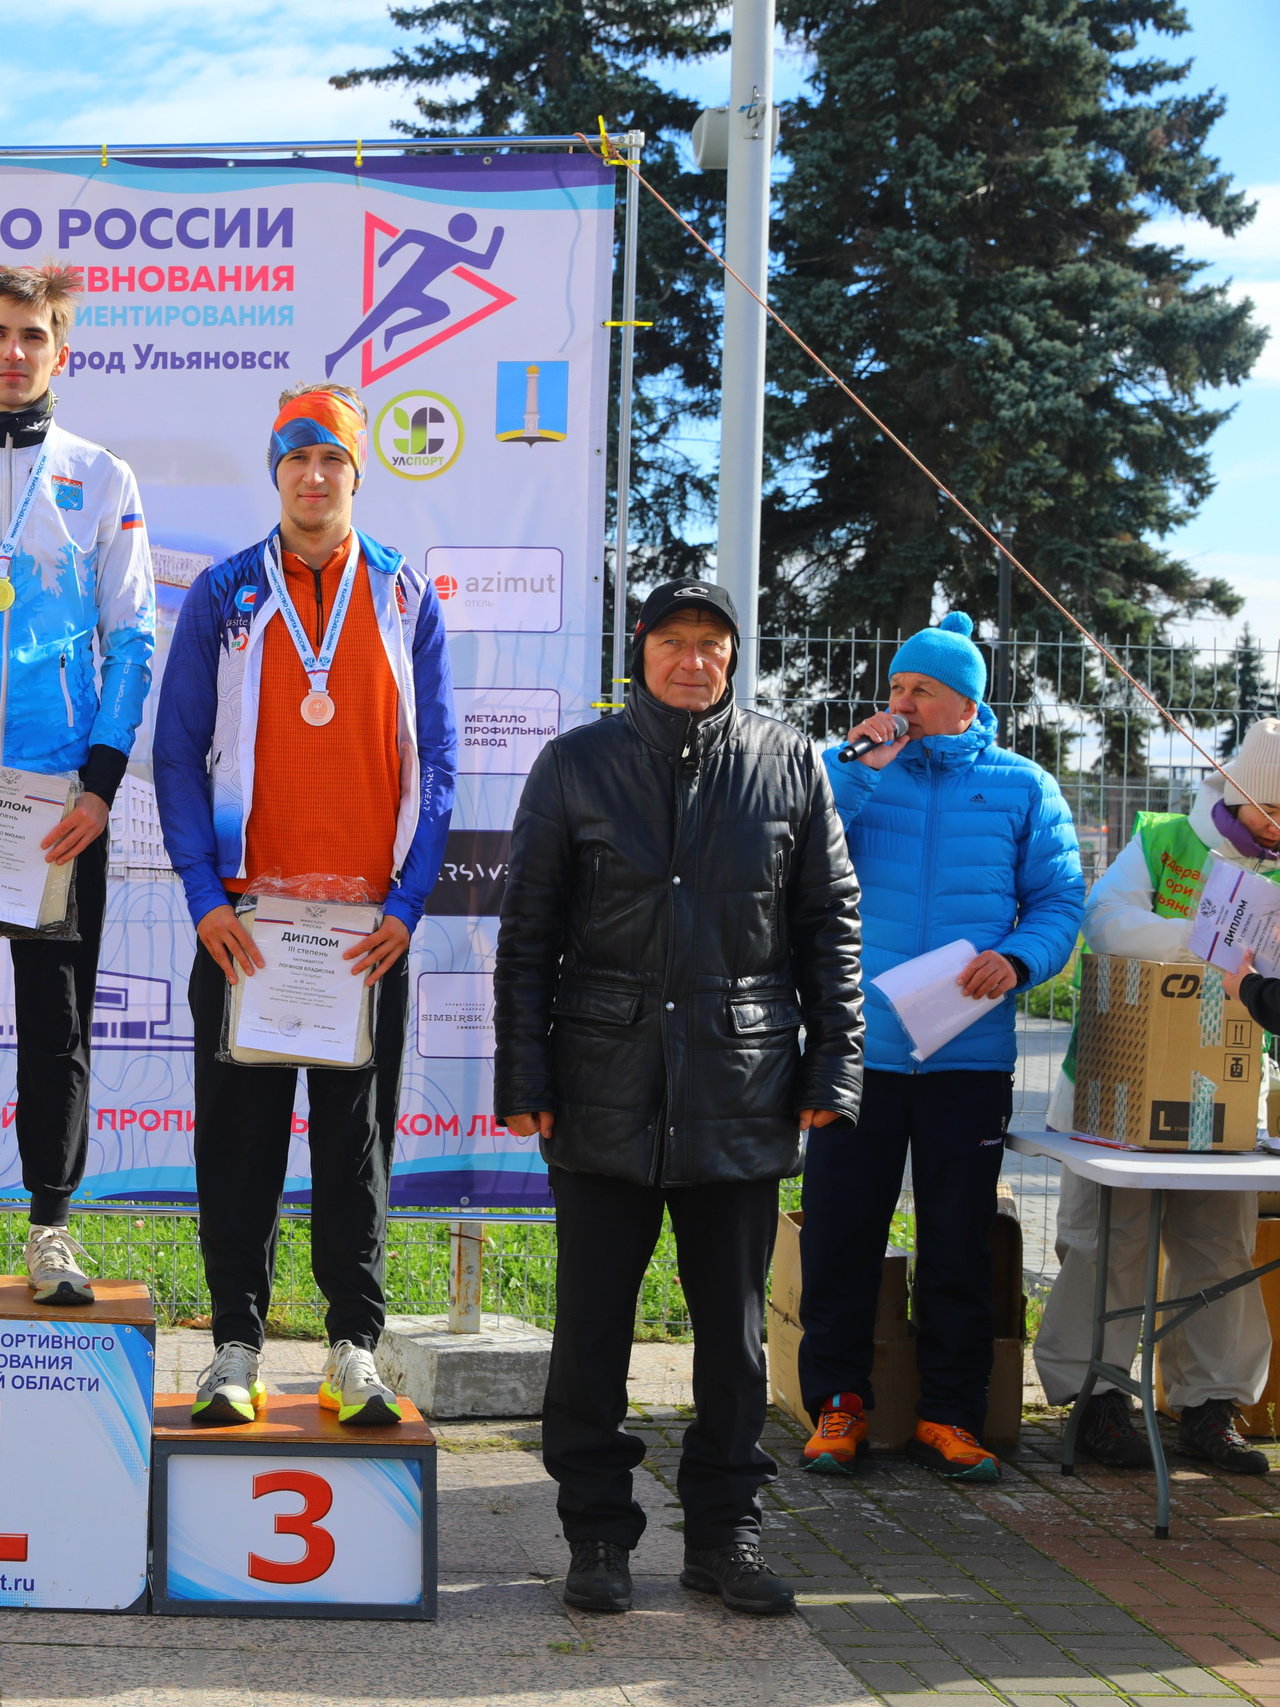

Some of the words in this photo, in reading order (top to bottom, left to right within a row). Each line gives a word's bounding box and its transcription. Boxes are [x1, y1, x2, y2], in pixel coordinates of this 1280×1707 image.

[59, 206, 294, 250] РОССИИ
[134, 343, 291, 371] Ульяновск
[392, 455, 445, 467] УЛСПОРТ
[10, 497, 31, 538] МИНИСТЕРСТВО
[27, 476, 39, 497] СПОРТА
[464, 573, 556, 594] azimut
[269, 567, 288, 608] МИНИСТЕРСТВО
[285, 607, 298, 629] СПОРТА
[294, 629, 308, 653] РОССИИ
[464, 600, 494, 608] ОТЕЛЬ
[326, 608, 341, 651] МИНИСТЕРСТВО
[338, 588, 347, 609] СПОРТА
[464, 714, 527, 724] МЕТАЛЛО
[464, 724, 557, 736] ПРОФИЛЬНЫЙ
[464, 738, 508, 748] ЗАВОД
[1221, 898, 1250, 947] ДИПЛОМ
[281, 931, 339, 948] ДИПЛОМ
[296, 947, 328, 957] степень
[1232, 1065, 1242, 1073] 12
[1158, 1110, 1172, 1131] L
[11, 1375, 100, 1393] ОБЛАСТИ
[248, 1469, 335, 1585] 3
